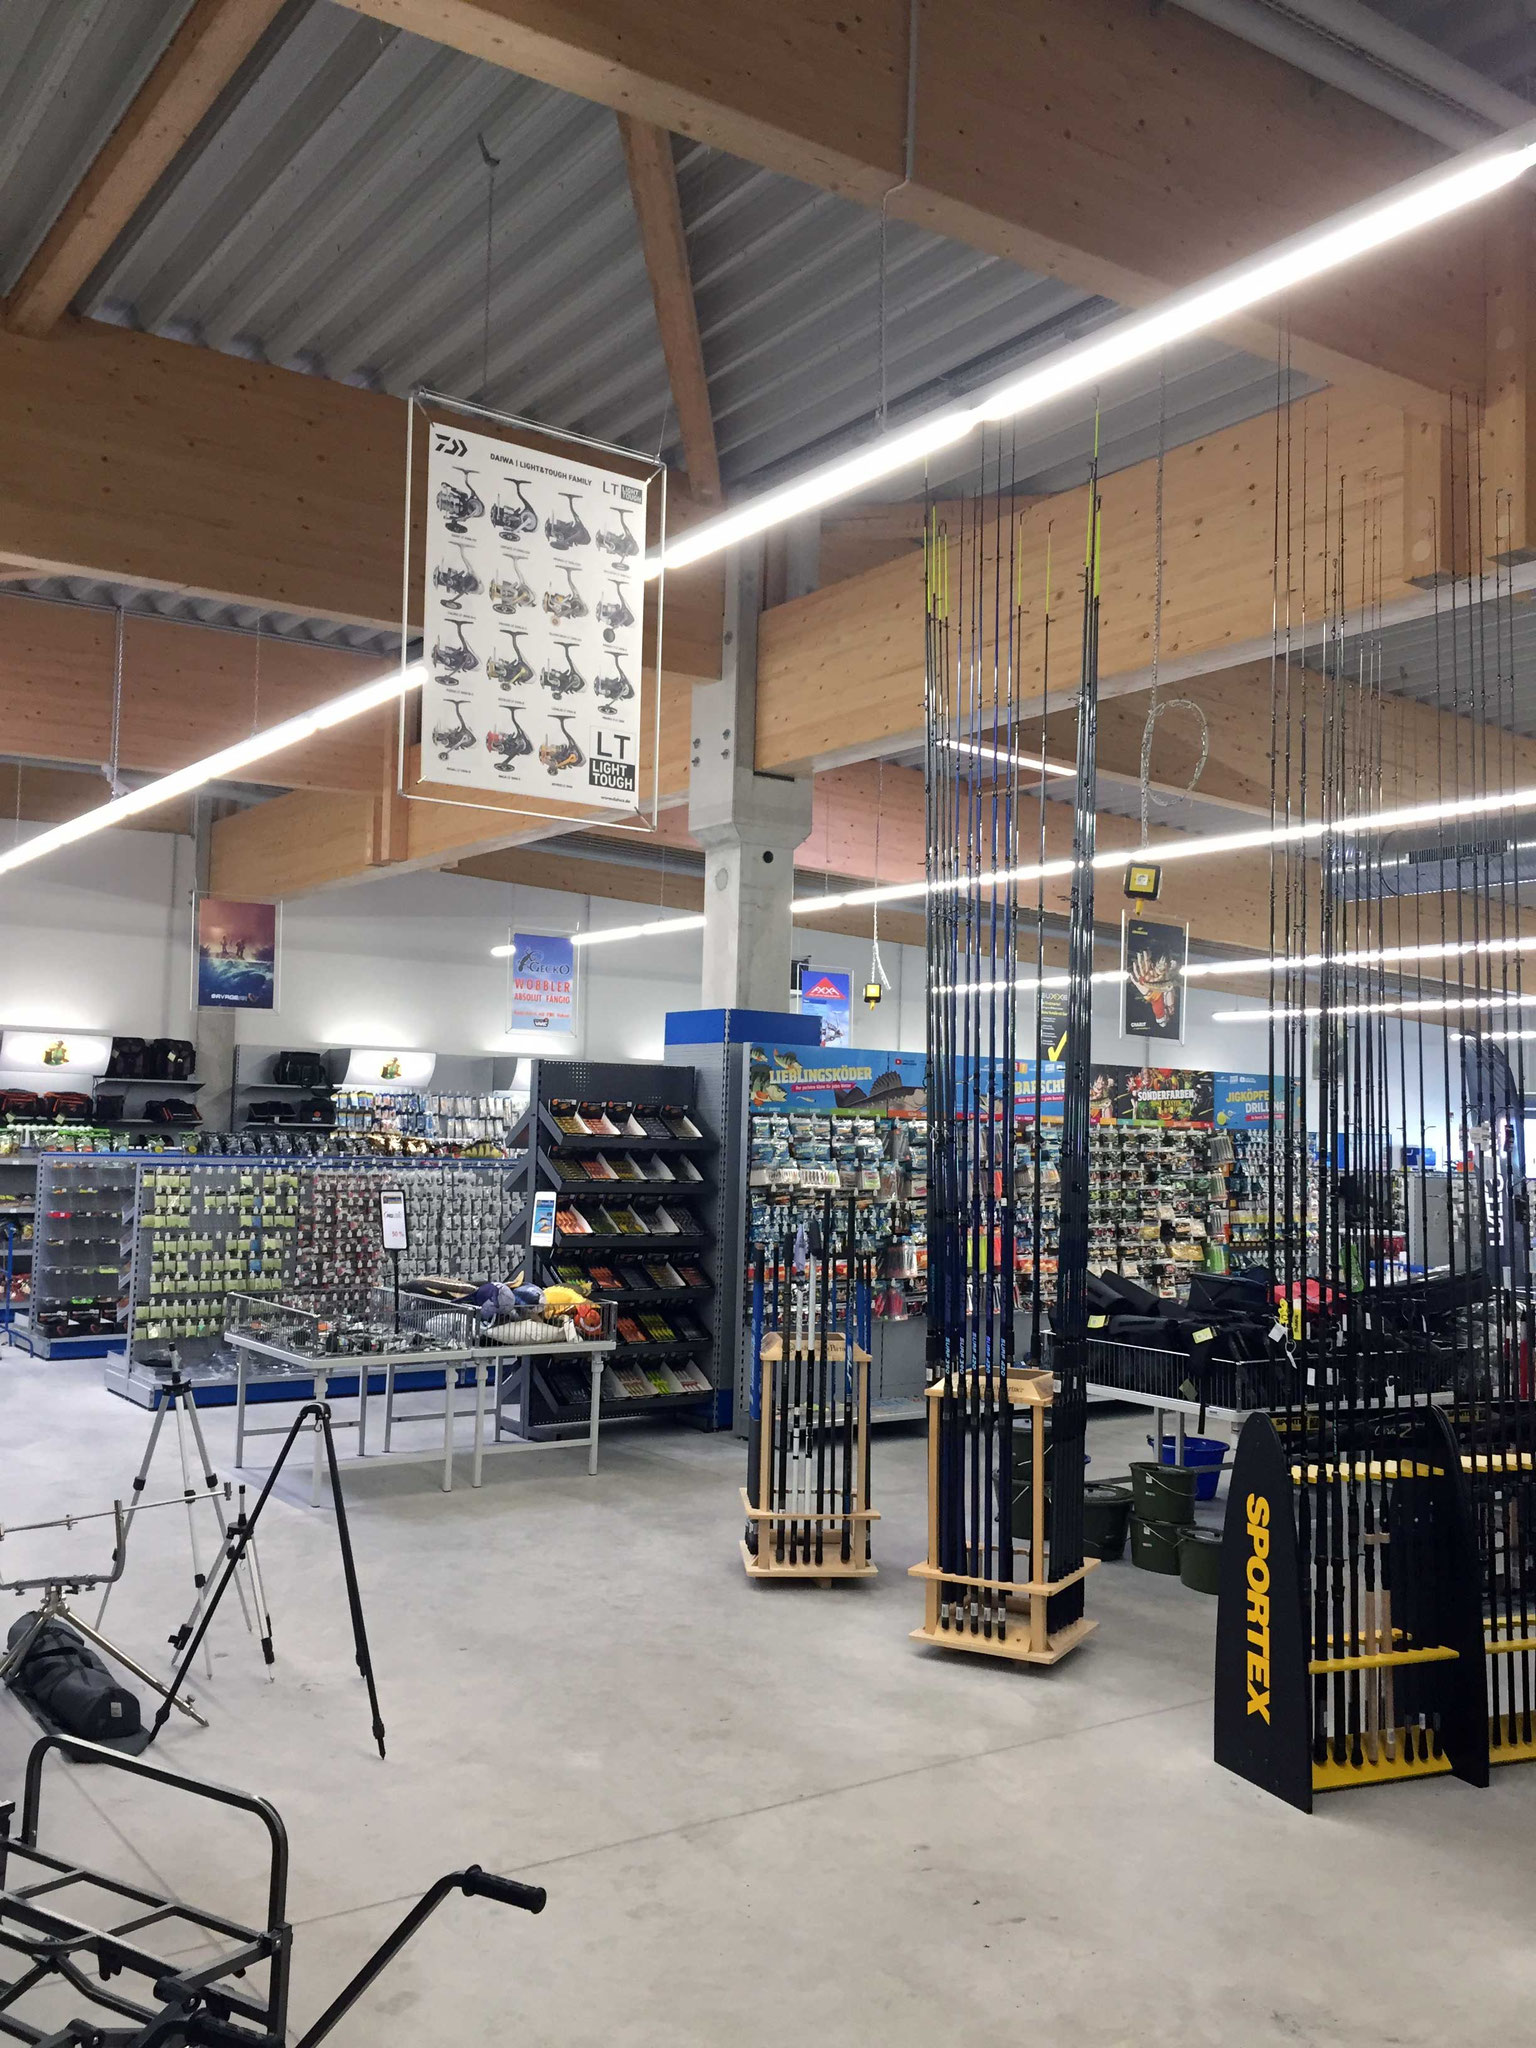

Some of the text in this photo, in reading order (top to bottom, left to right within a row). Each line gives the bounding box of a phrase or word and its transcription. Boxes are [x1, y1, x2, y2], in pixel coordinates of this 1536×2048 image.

[489, 452, 592, 486] DAIWA LIGHT&TOUGH FAMILY
[602, 480, 619, 496] LT
[622, 486, 639, 497] LIGHT
[622, 492, 642, 504] TOUGH
[597, 731, 631, 760] LT
[592, 760, 627, 777] LIGHT
[592, 773, 633, 790] TOUGH
[528, 961, 570, 975] GECKO
[514, 978, 571, 993] WOBBLER
[514, 992, 571, 1004] ABSOLUT FANGIG
[769, 1065, 872, 1084] LIEBLINGSKÖDER
[1137, 1088, 1195, 1102] SONDERFARBEN
[1245, 1101, 1285, 1113] DRILLNG
[1246, 1492, 1271, 1726] SPORTEX
